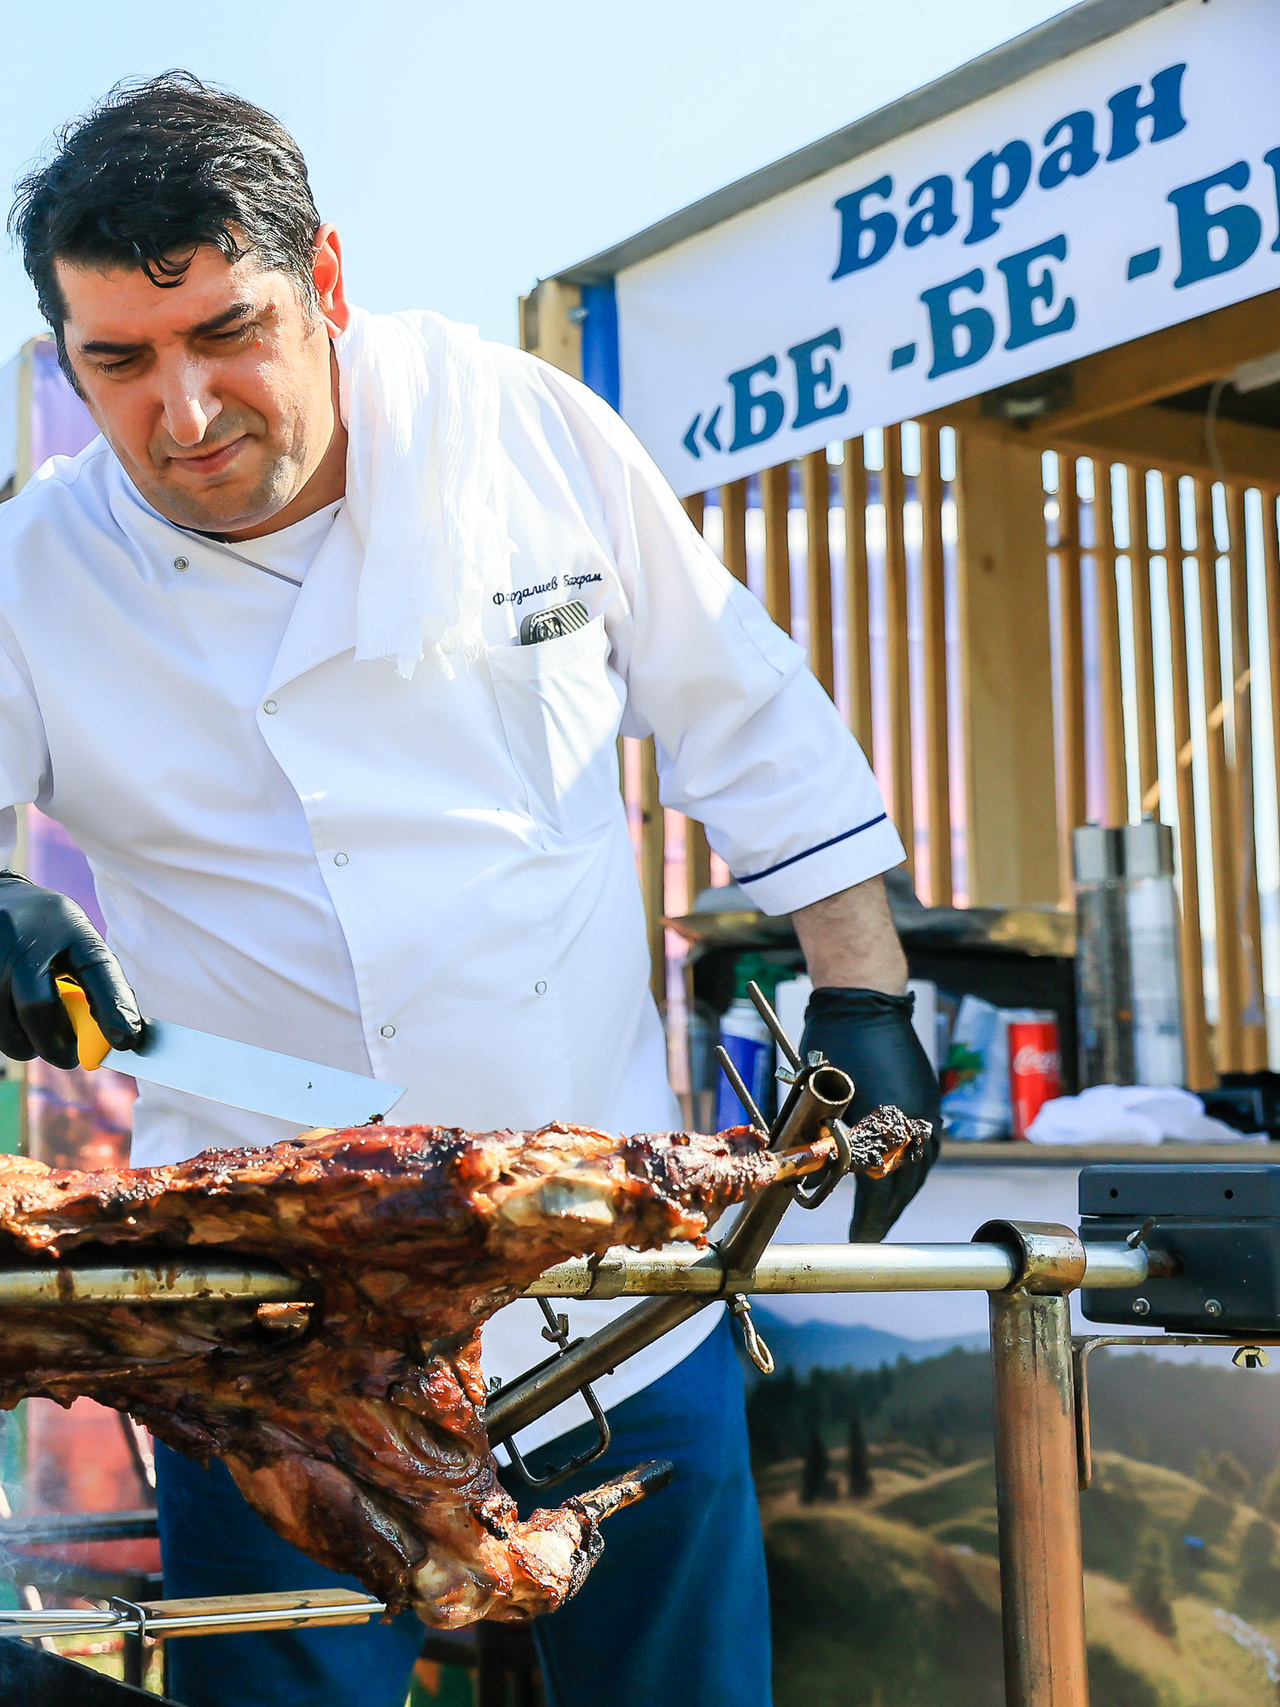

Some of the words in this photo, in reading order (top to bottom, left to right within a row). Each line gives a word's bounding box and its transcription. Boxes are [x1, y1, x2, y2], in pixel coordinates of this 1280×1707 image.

[682, 327, 850, 459] «БЕ
[1127, 146, 1280, 290] -Б
[830, 62, 1188, 281] Баран
